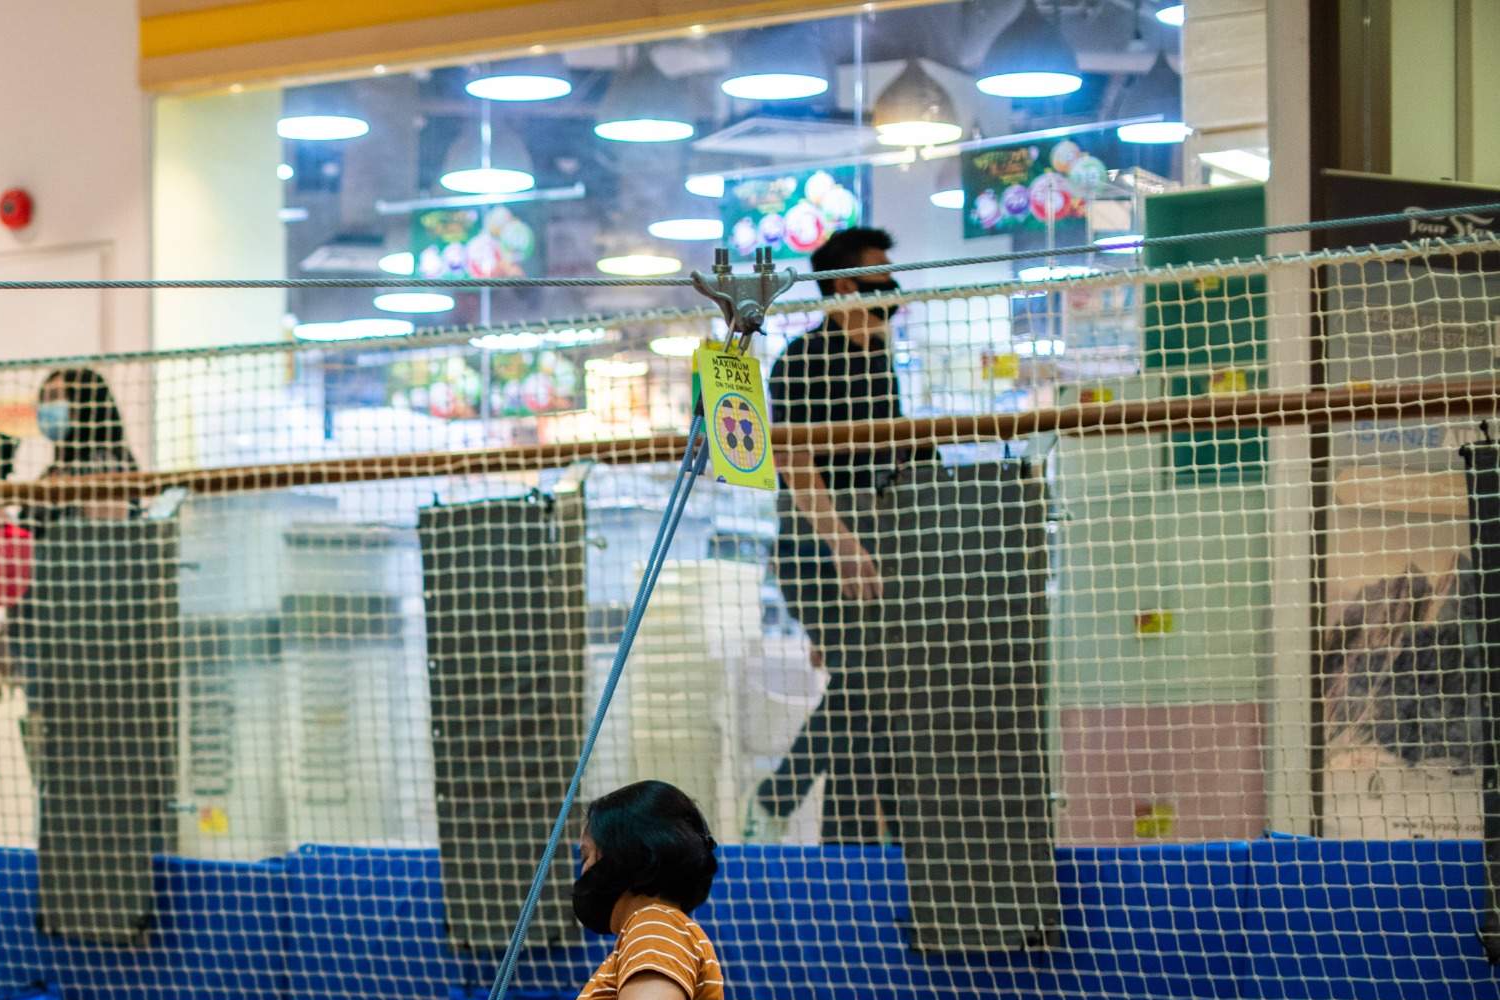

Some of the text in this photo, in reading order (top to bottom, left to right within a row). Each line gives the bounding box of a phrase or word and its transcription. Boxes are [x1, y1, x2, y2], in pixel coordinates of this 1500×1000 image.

[712, 358, 749, 370] MAXIMUM
[714, 366, 751, 384] 2 PAX
